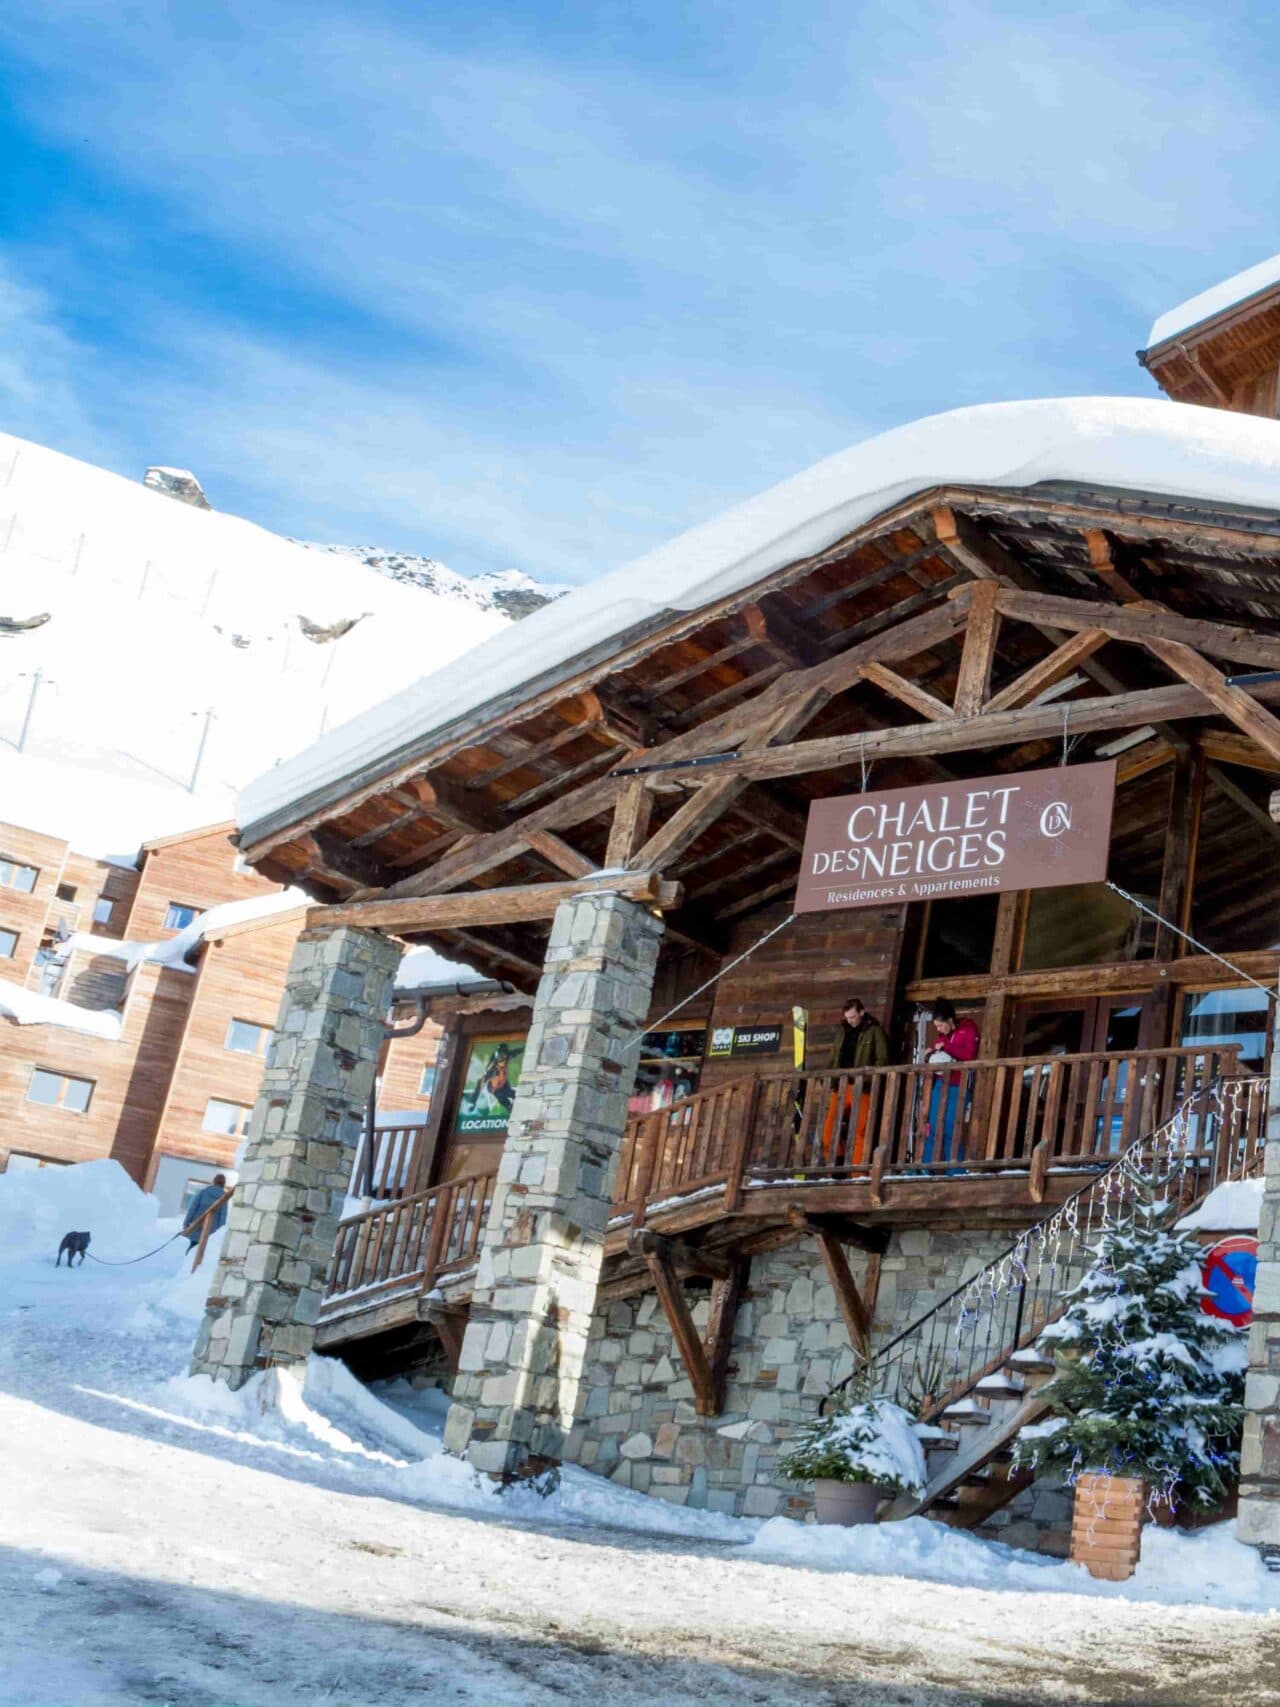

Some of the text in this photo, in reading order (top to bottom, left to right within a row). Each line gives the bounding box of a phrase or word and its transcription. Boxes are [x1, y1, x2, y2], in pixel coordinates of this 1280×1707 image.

[847, 787, 1020, 842] CHALET
[827, 875, 1000, 903] Residences & Appartements
[738, 1032, 776, 1043] SKI SHOP
